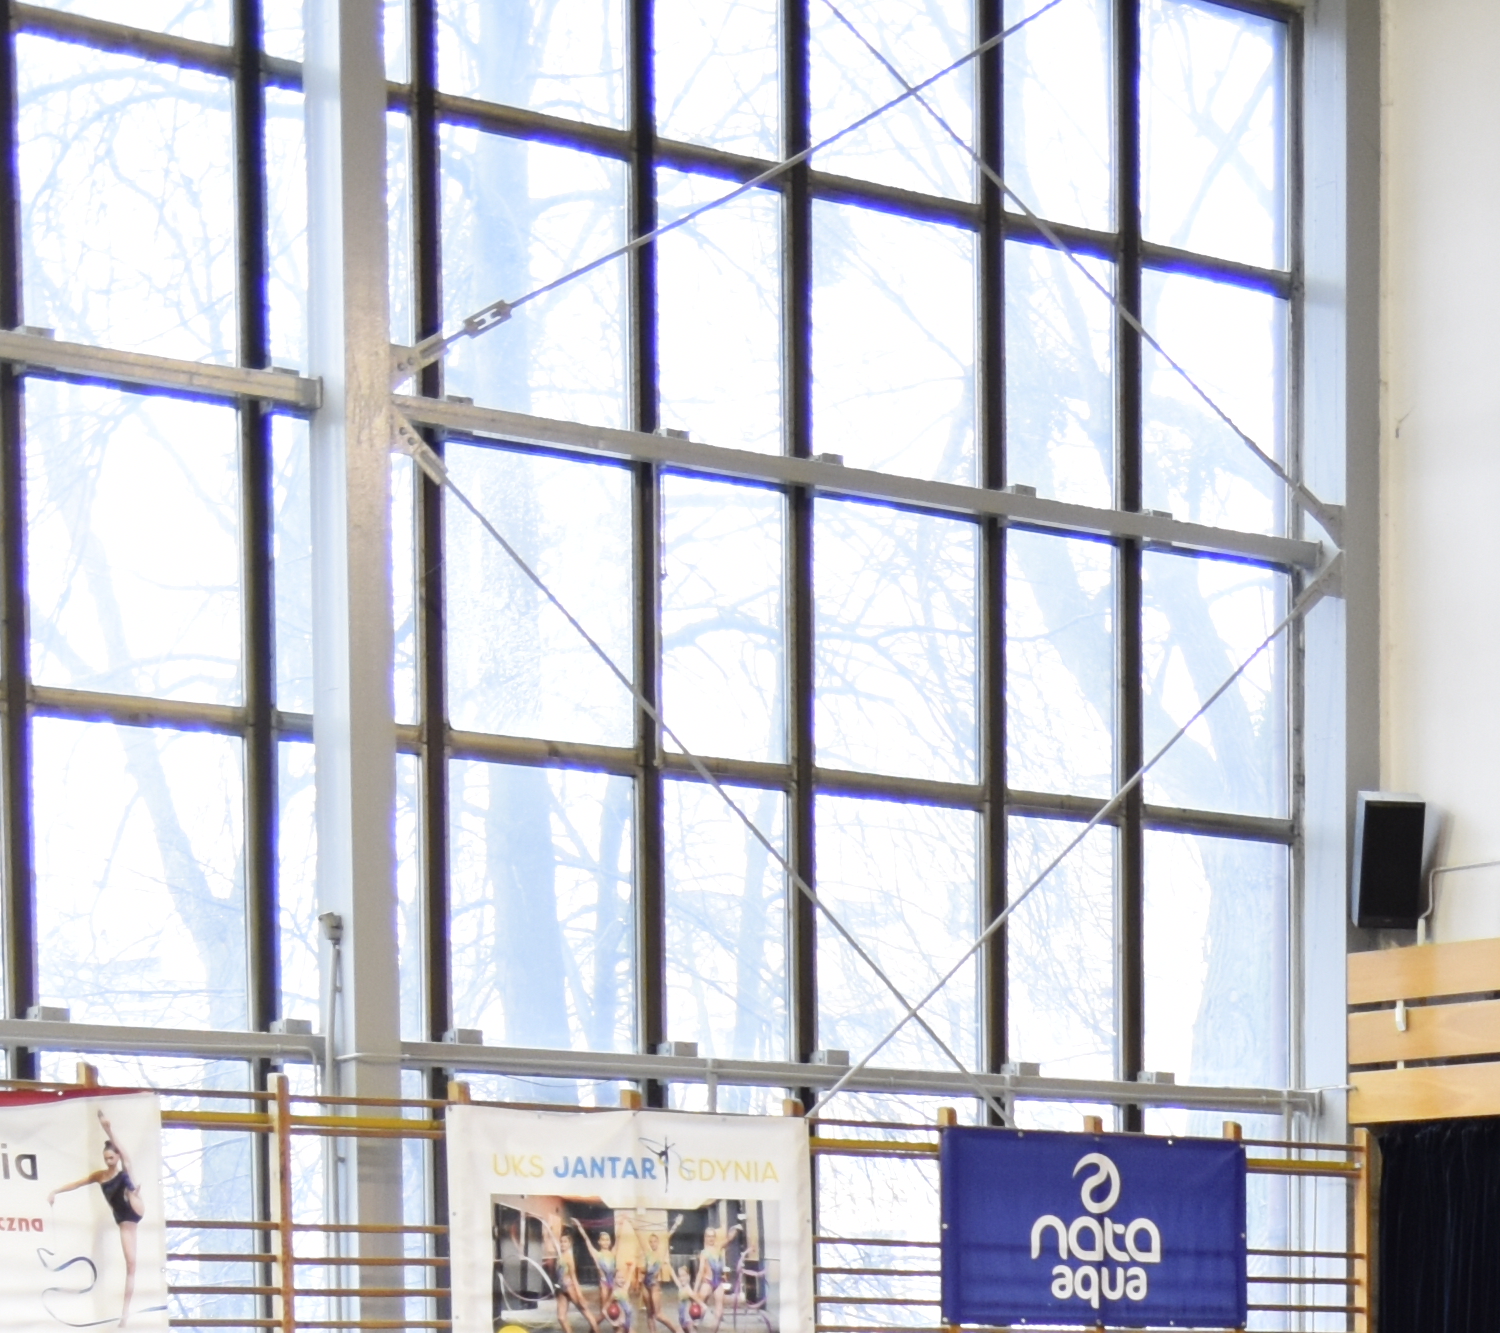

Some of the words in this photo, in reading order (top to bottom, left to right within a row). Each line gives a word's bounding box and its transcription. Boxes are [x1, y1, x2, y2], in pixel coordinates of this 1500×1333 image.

[492, 1153, 545, 1178] UKS
[553, 1155, 657, 1181] JANTAR
[678, 1157, 780, 1184] GDYNIA
[1030, 1214, 1162, 1263] nata
[1051, 1264, 1148, 1310] aqua
